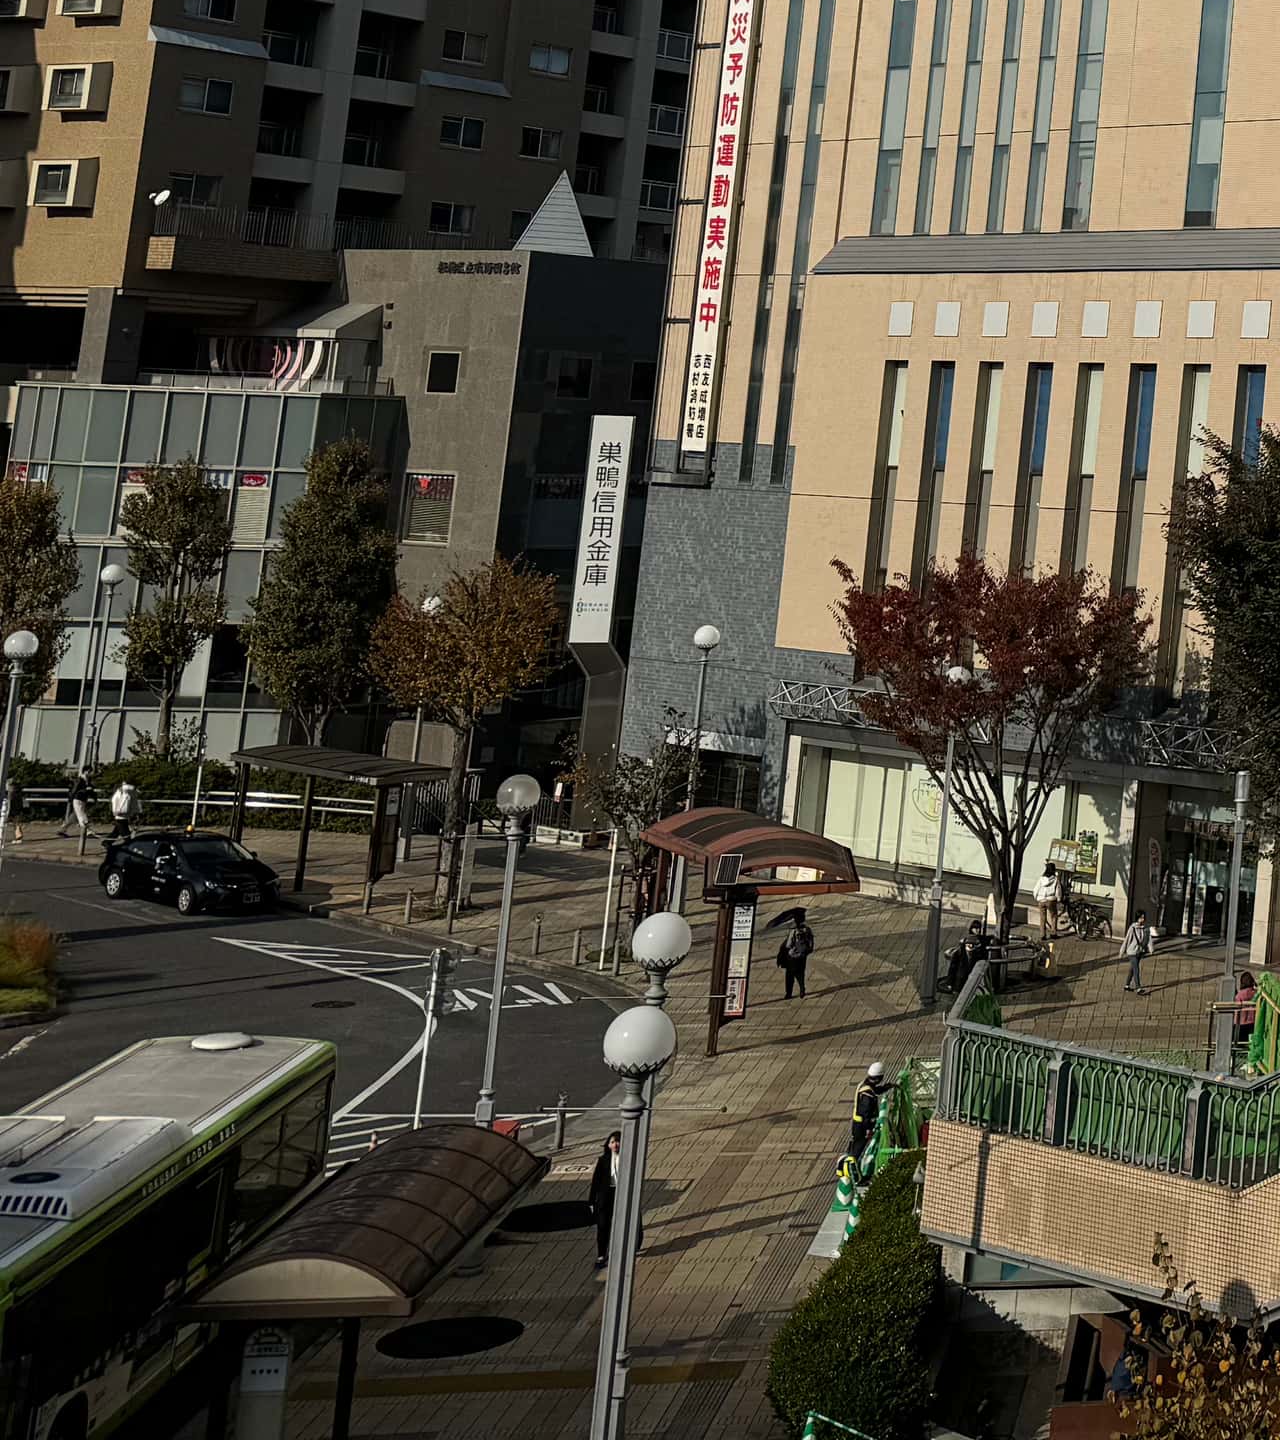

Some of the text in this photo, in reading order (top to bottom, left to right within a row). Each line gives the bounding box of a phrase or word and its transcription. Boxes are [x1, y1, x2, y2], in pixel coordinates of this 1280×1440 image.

[582, 442, 622, 587] 巣鴨信用金庫
